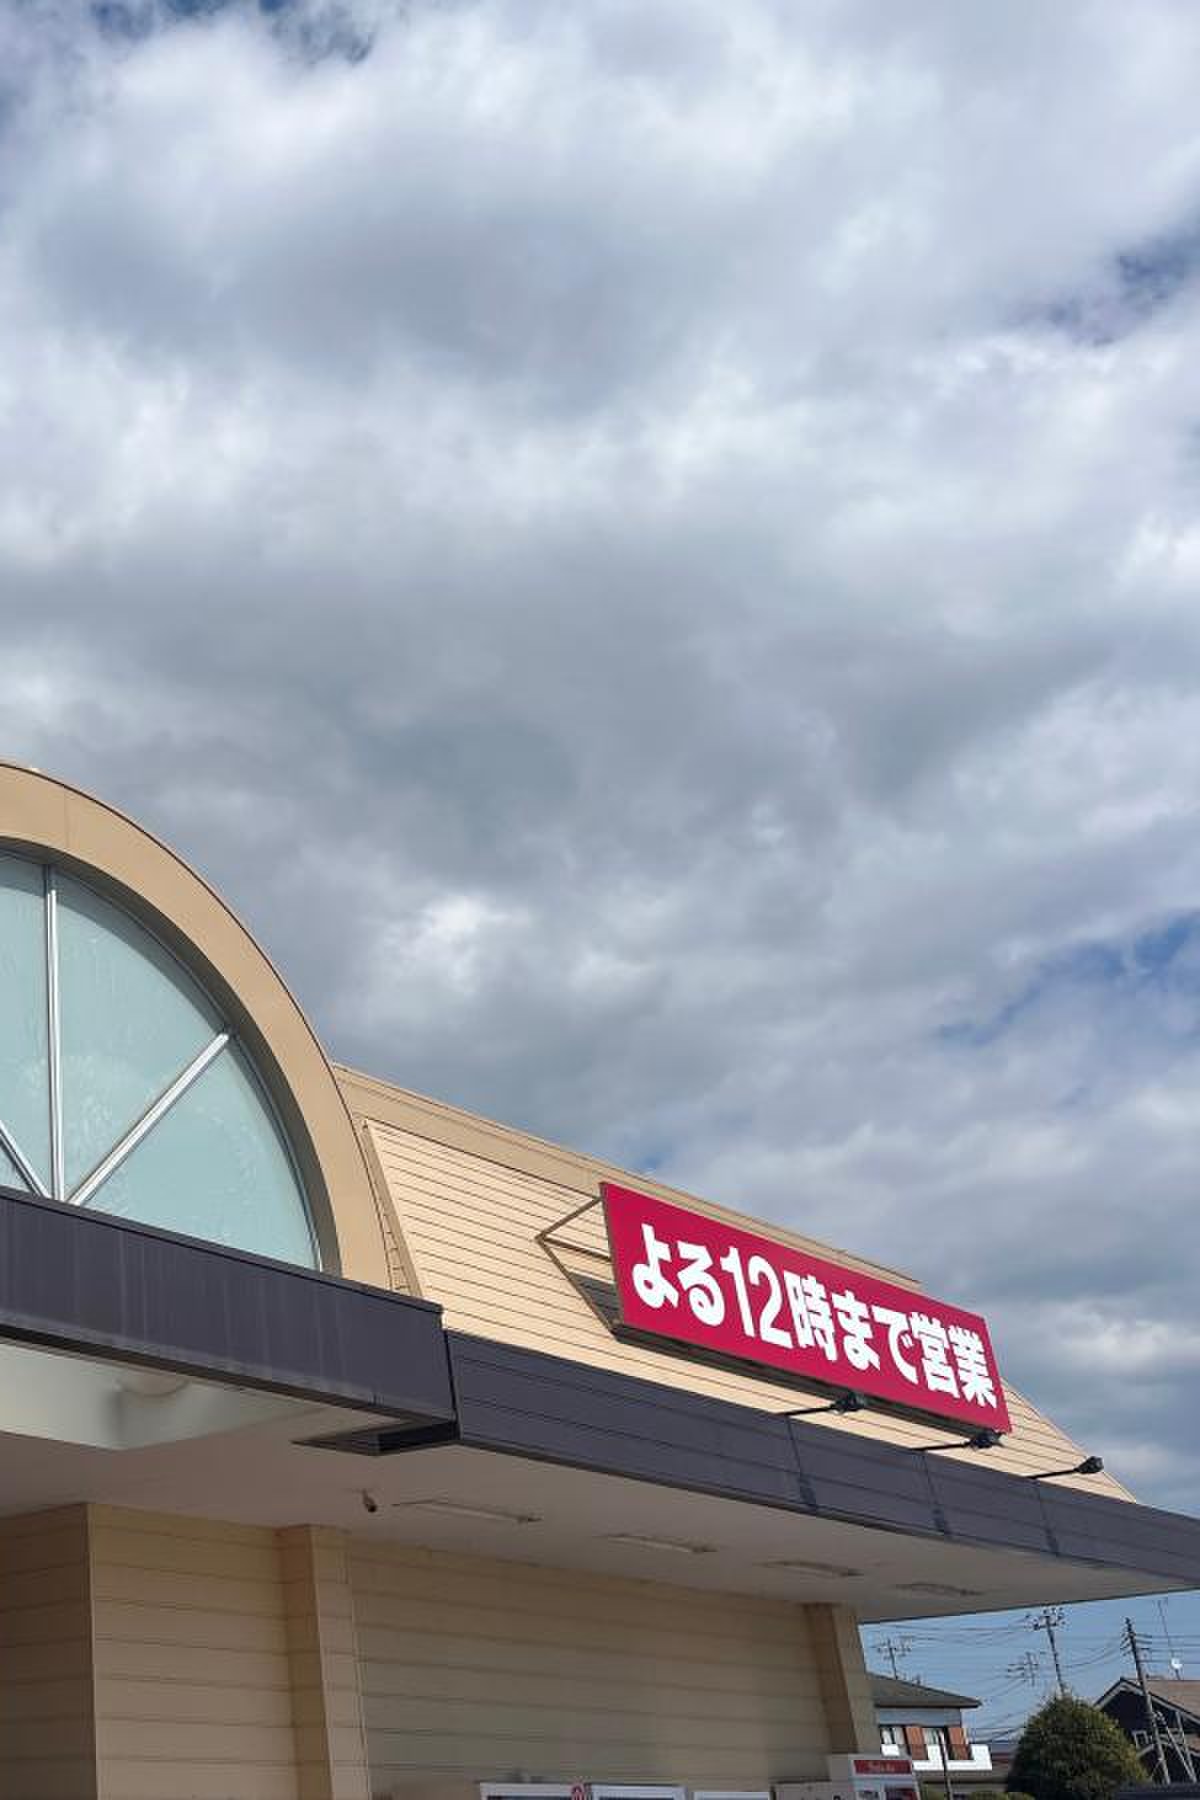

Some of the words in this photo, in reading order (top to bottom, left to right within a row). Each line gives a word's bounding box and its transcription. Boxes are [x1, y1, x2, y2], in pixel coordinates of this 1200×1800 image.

[632, 1223, 997, 1408] よる12時まで営業
